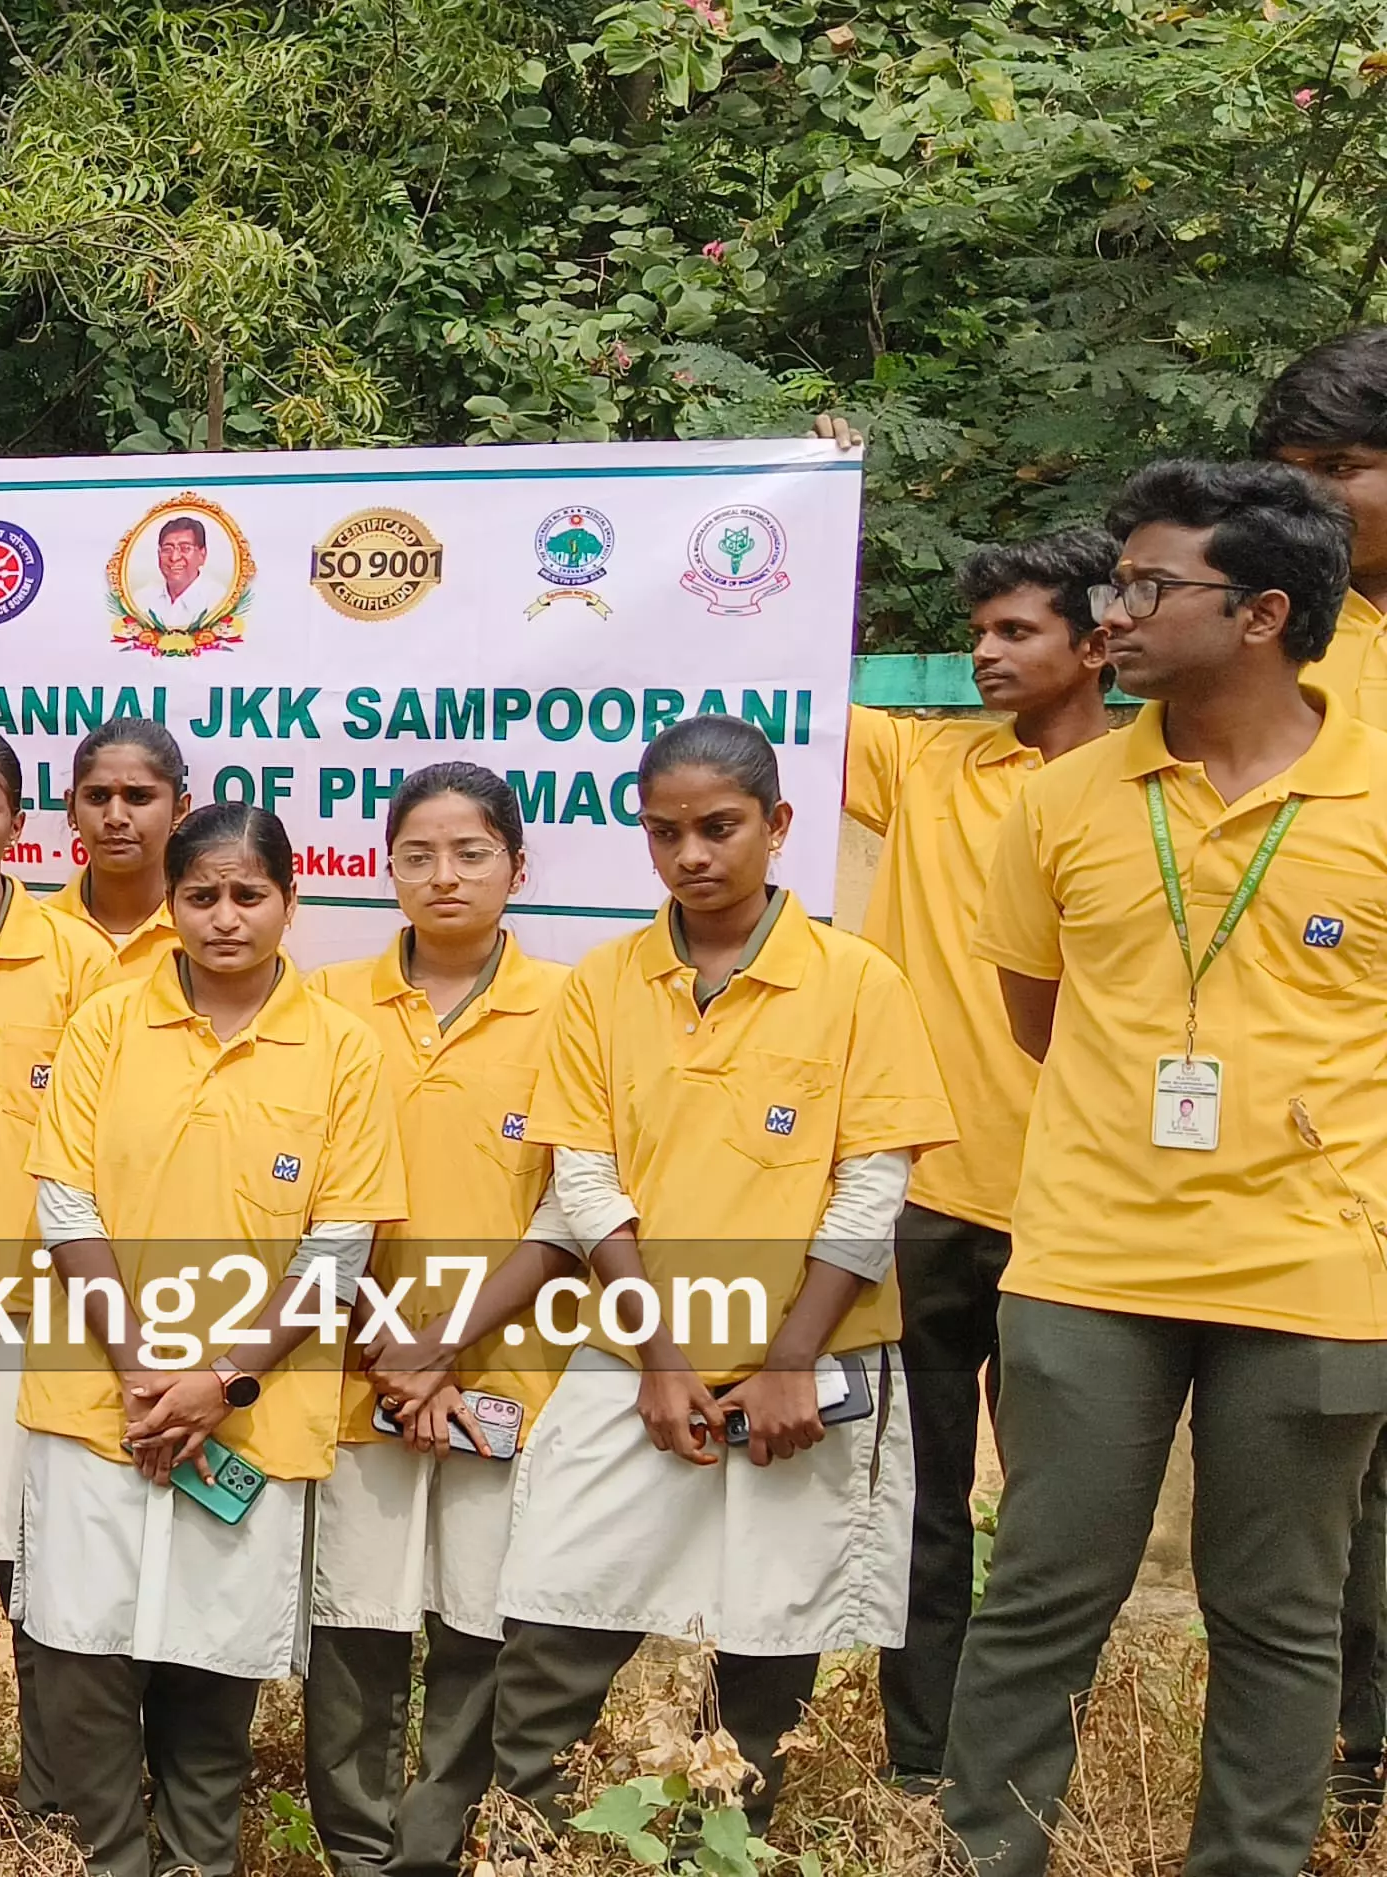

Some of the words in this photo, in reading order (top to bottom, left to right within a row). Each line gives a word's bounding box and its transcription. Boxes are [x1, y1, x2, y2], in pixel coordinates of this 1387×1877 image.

[337, 518, 416, 546] CERTIFICADO
[311, 551, 361, 579] ISO
[369, 550, 442, 578] 9001
[8, 577, 34, 609] SCHEME
[335, 582, 414, 611] CERTIFICADO
[189, 687, 321, 739] JKK
[213, 766, 295, 813] OF
[319, 768, 641, 826] PHMAC
[292, 846, 376, 878] akkal
[1309, 917, 1341, 935] M
[33, 1066, 51, 1078] M
[507, 1114, 525, 1126] M
[770, 1107, 794, 1122] M
[277, 1155, 299, 1170] M
